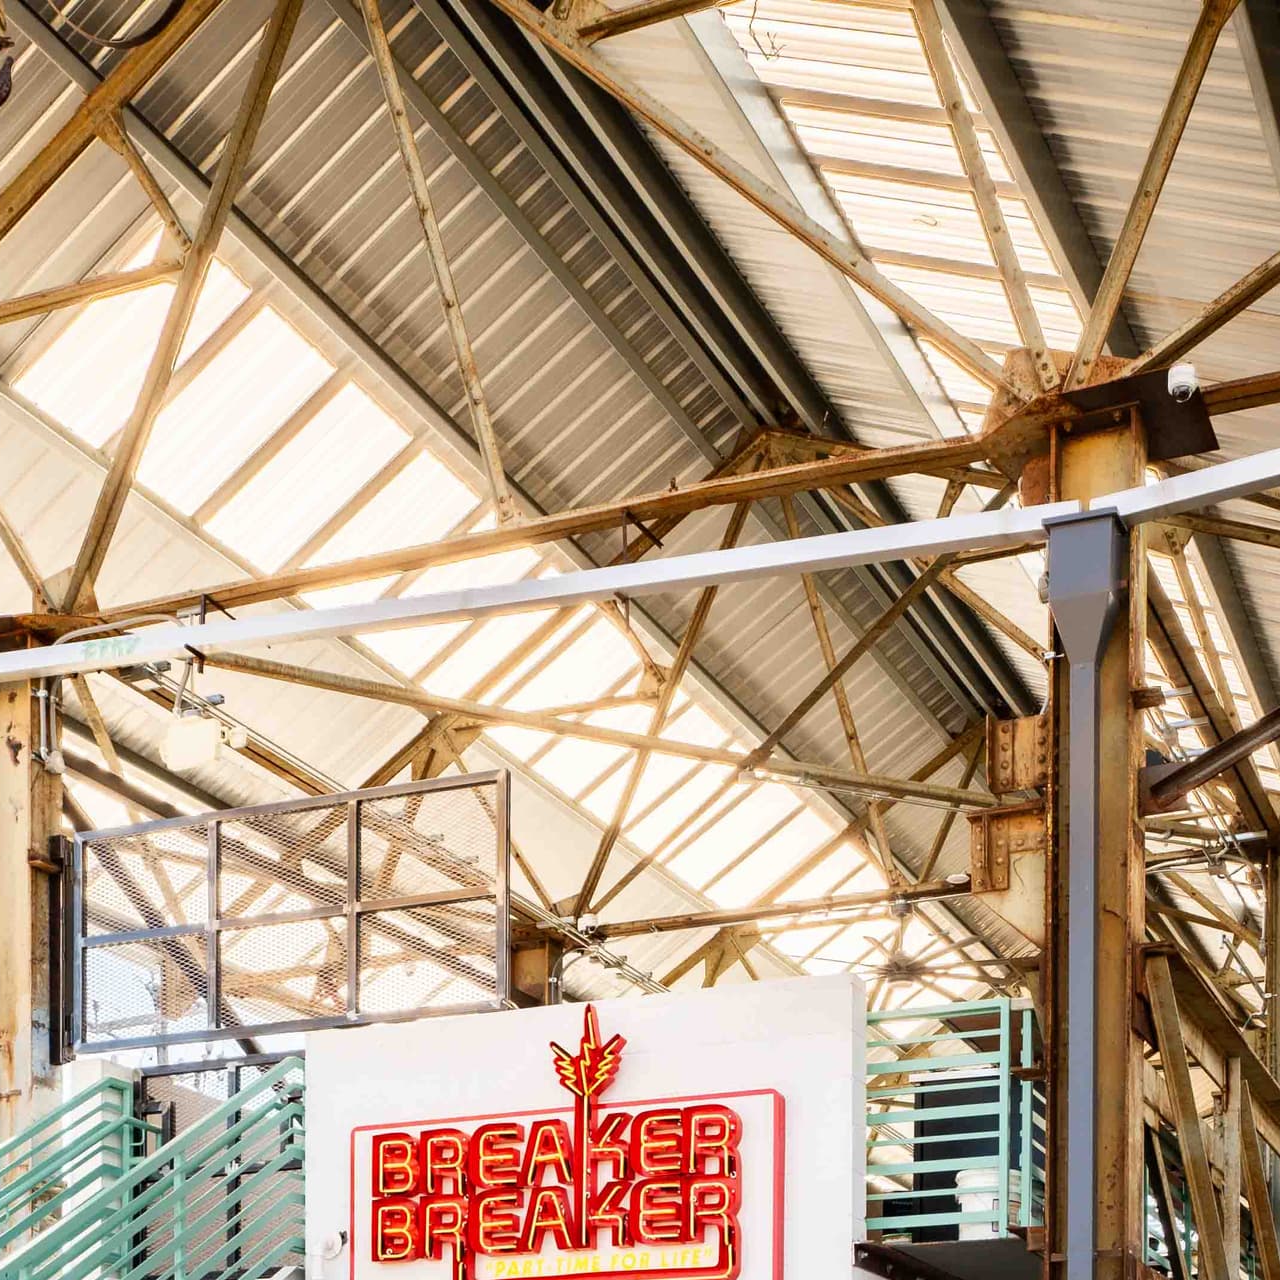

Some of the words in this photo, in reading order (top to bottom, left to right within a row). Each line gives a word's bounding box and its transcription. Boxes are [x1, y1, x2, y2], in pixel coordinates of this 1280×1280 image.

[371, 1104, 742, 1199] BREAKER
[371, 1179, 741, 1264] BREAKER
[610, 1251, 650, 1271] FOR
